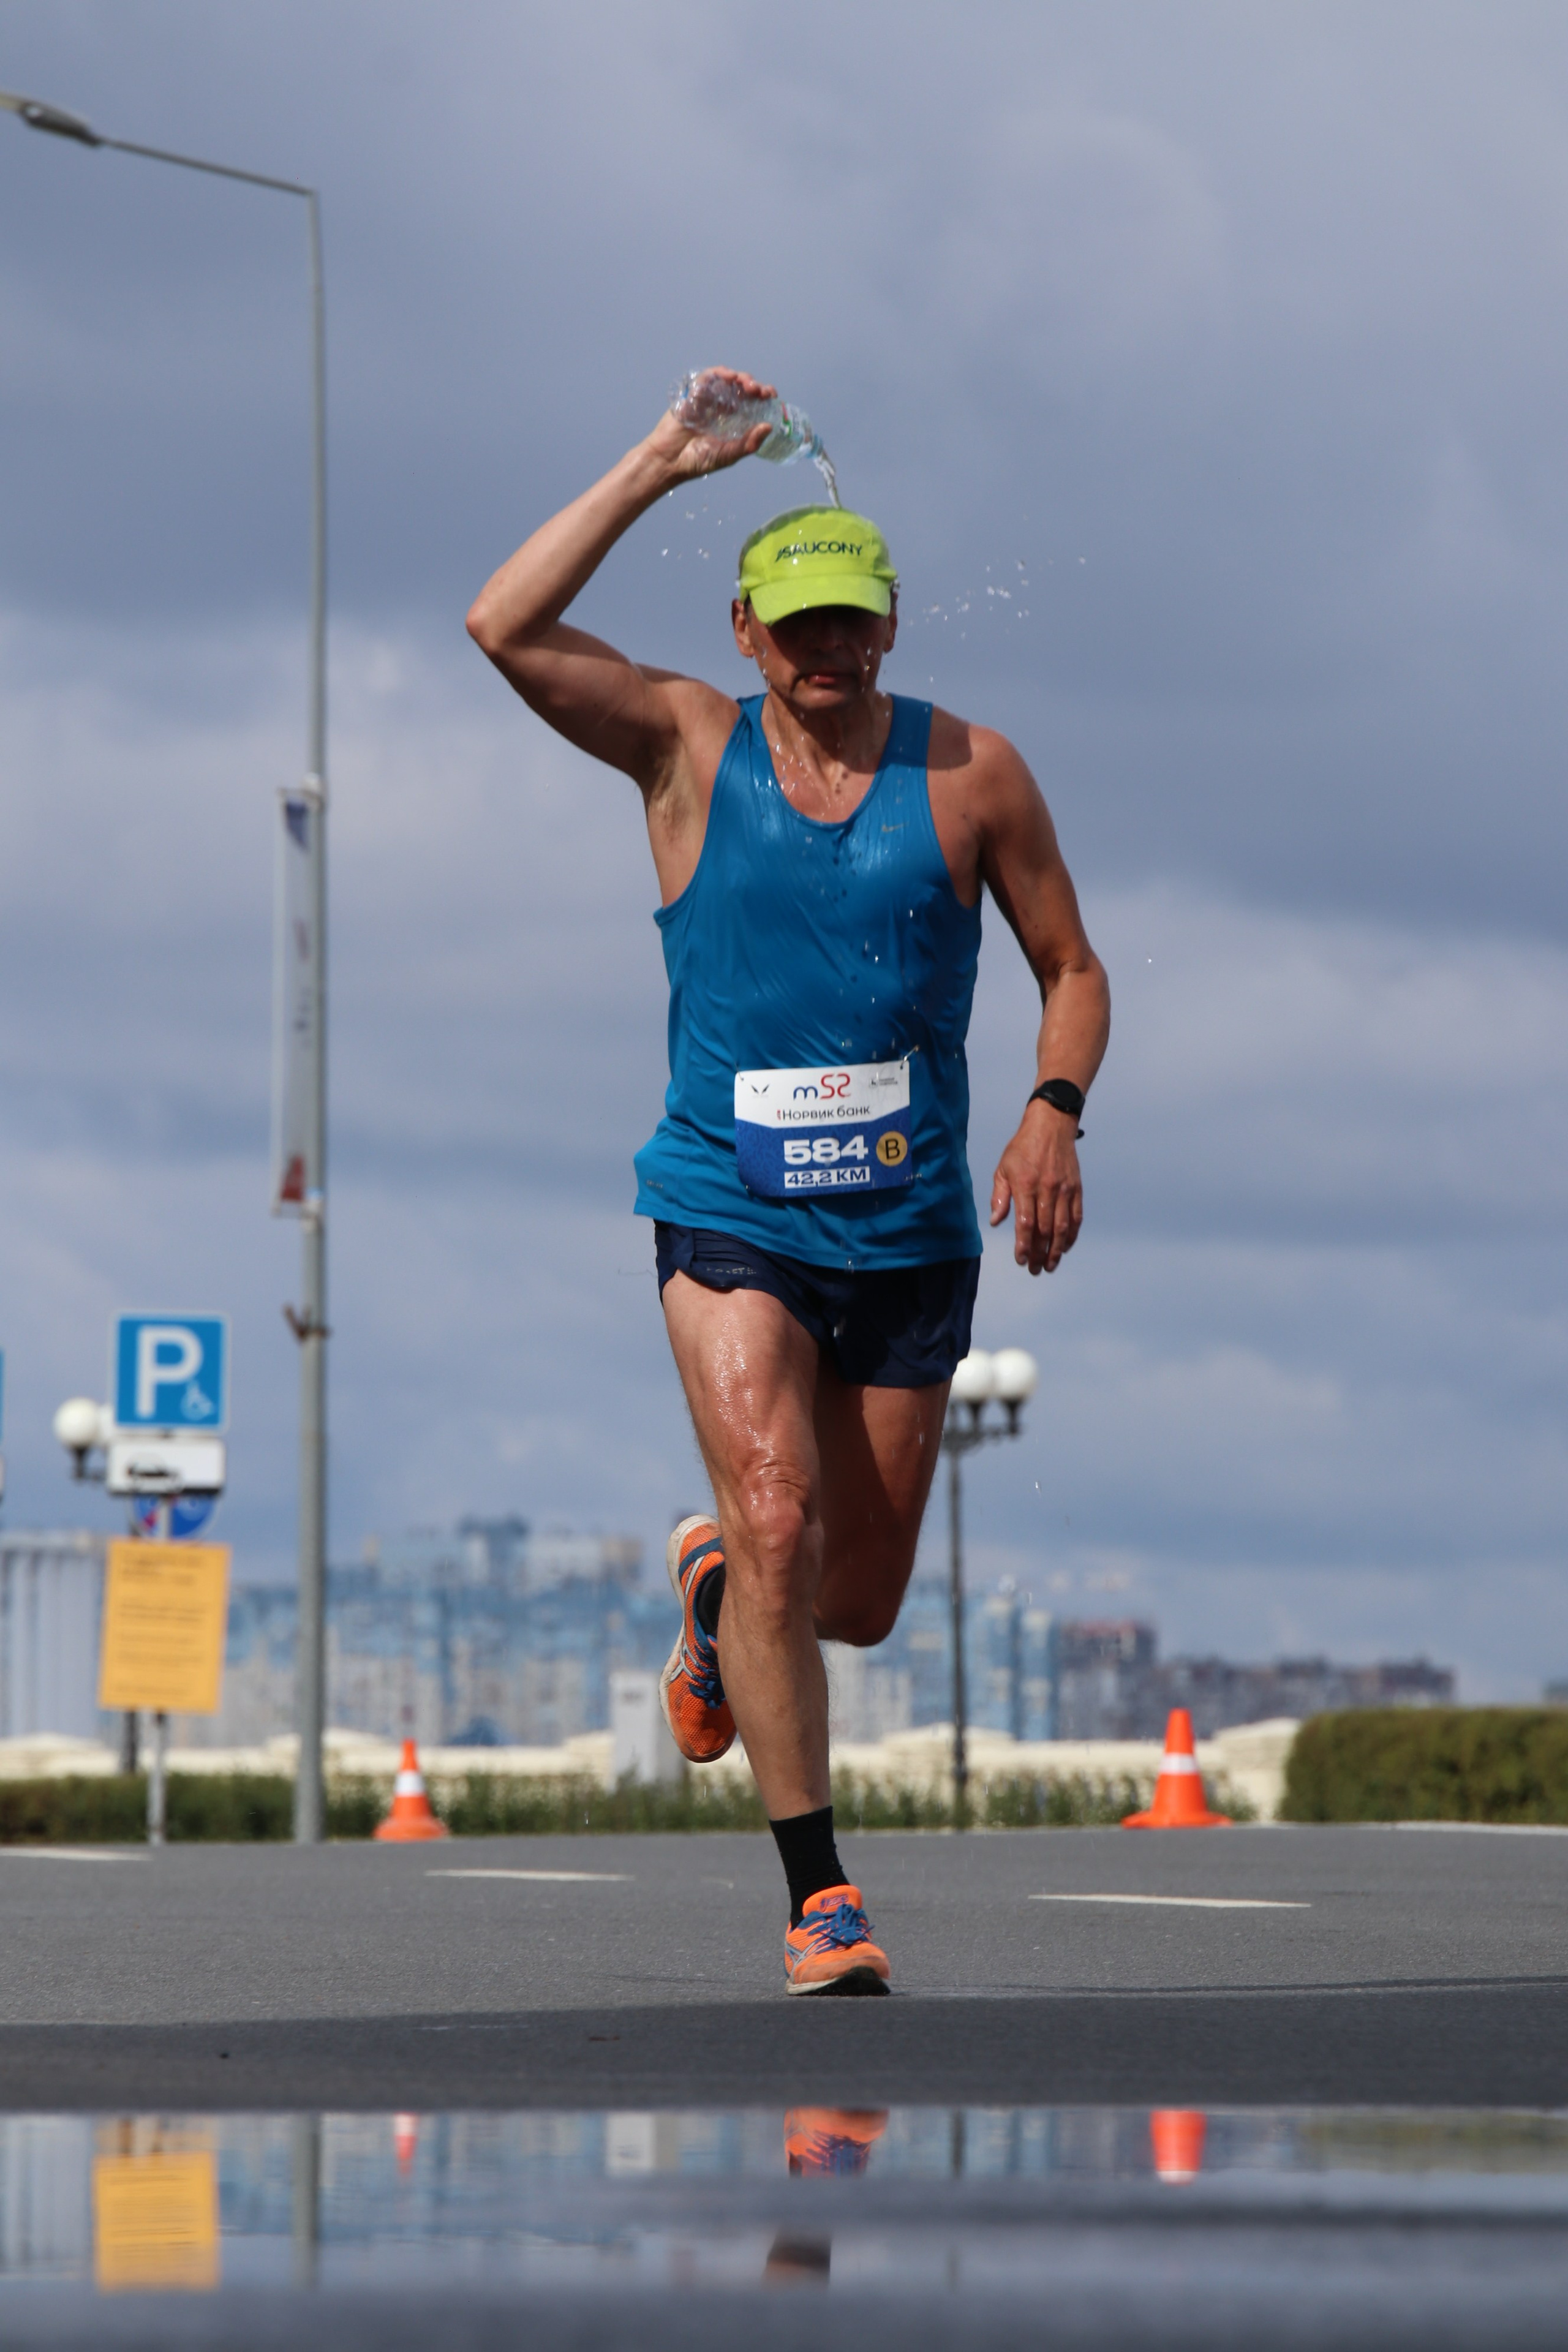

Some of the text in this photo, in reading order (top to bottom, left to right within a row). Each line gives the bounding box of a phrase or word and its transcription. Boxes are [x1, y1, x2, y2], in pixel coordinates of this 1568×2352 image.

[784, 1135, 869, 1165] 584
[787, 1170, 832, 1187] 42,2
[137, 1325, 203, 1418] P
